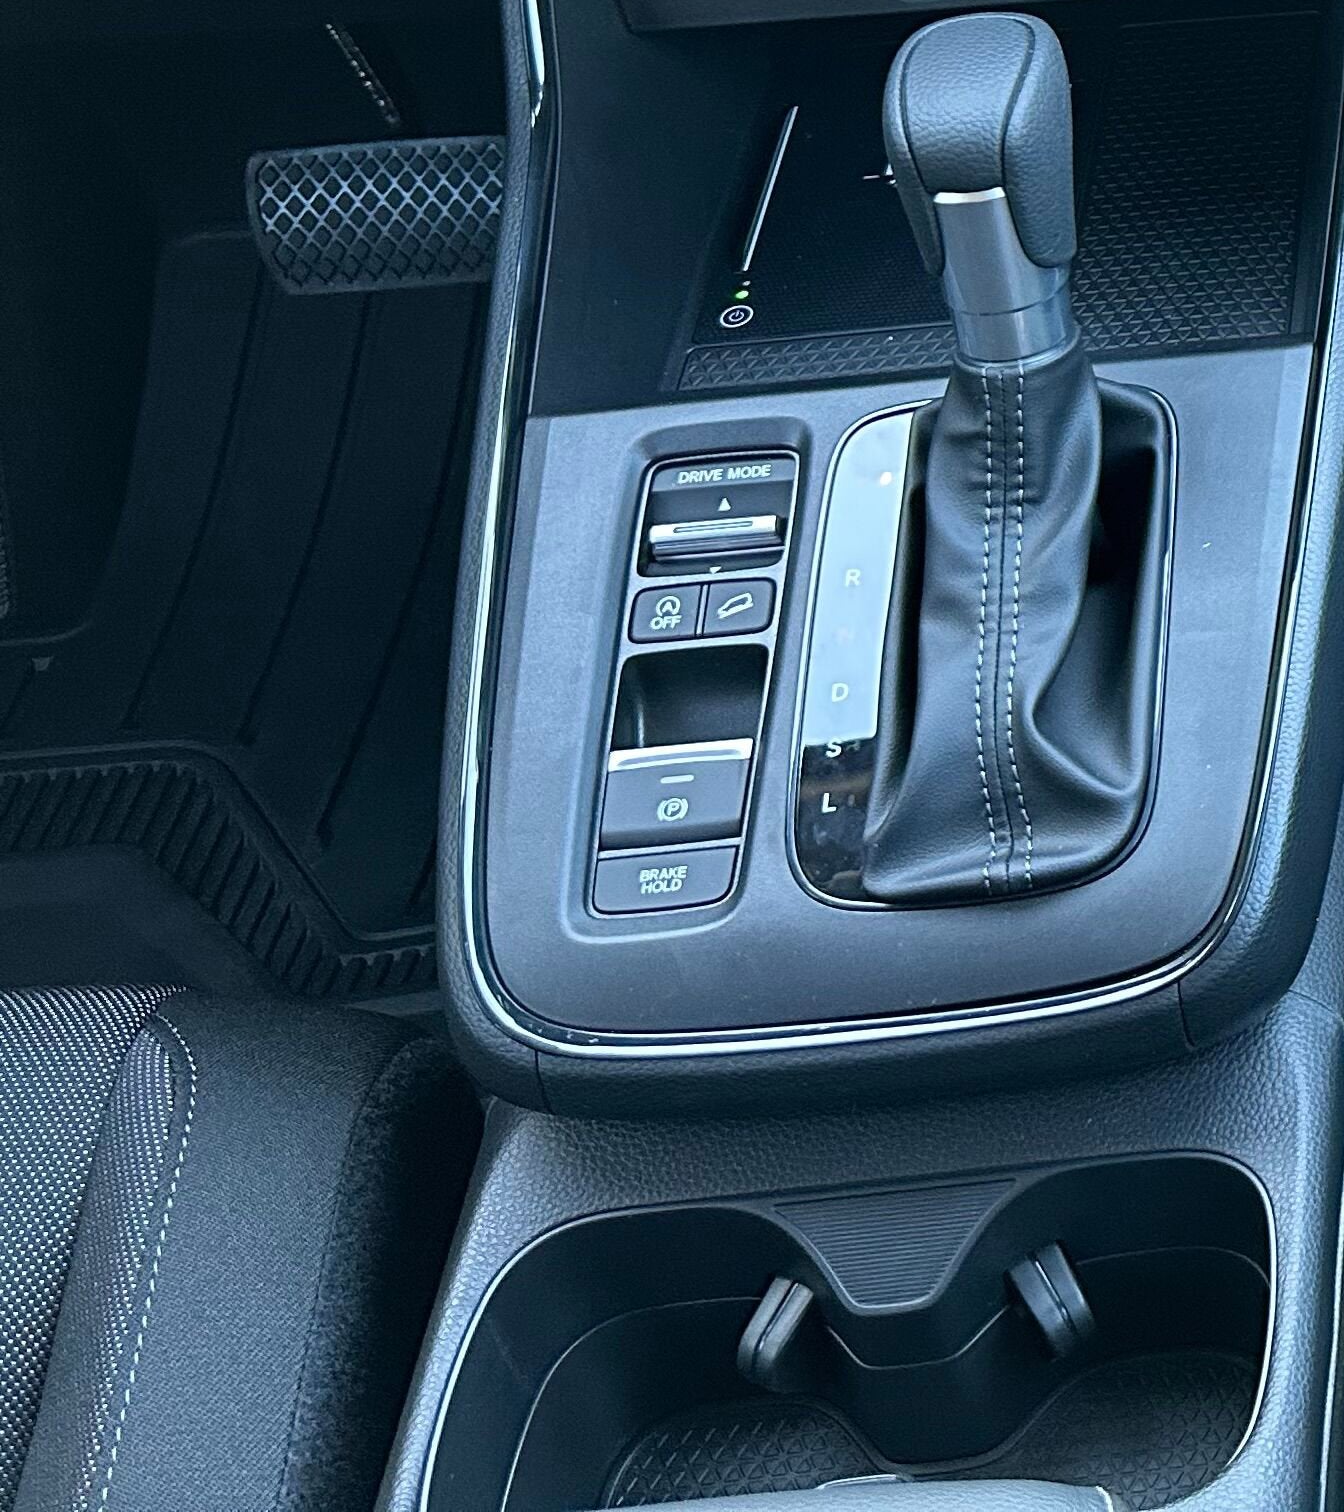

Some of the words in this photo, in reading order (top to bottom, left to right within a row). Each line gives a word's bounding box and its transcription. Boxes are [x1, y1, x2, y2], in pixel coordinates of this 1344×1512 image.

[677, 468, 723, 484] DRIVE
[727, 464, 772, 480] MODE
[844, 568, 861, 587] R
[650, 614, 683, 630] OFF
[831, 682, 849, 702] D
[826, 737, 842, 758] S
[821, 792, 837, 813] L
[640, 865, 688, 883] BRAKE
[641, 878, 683, 894] HOLD
